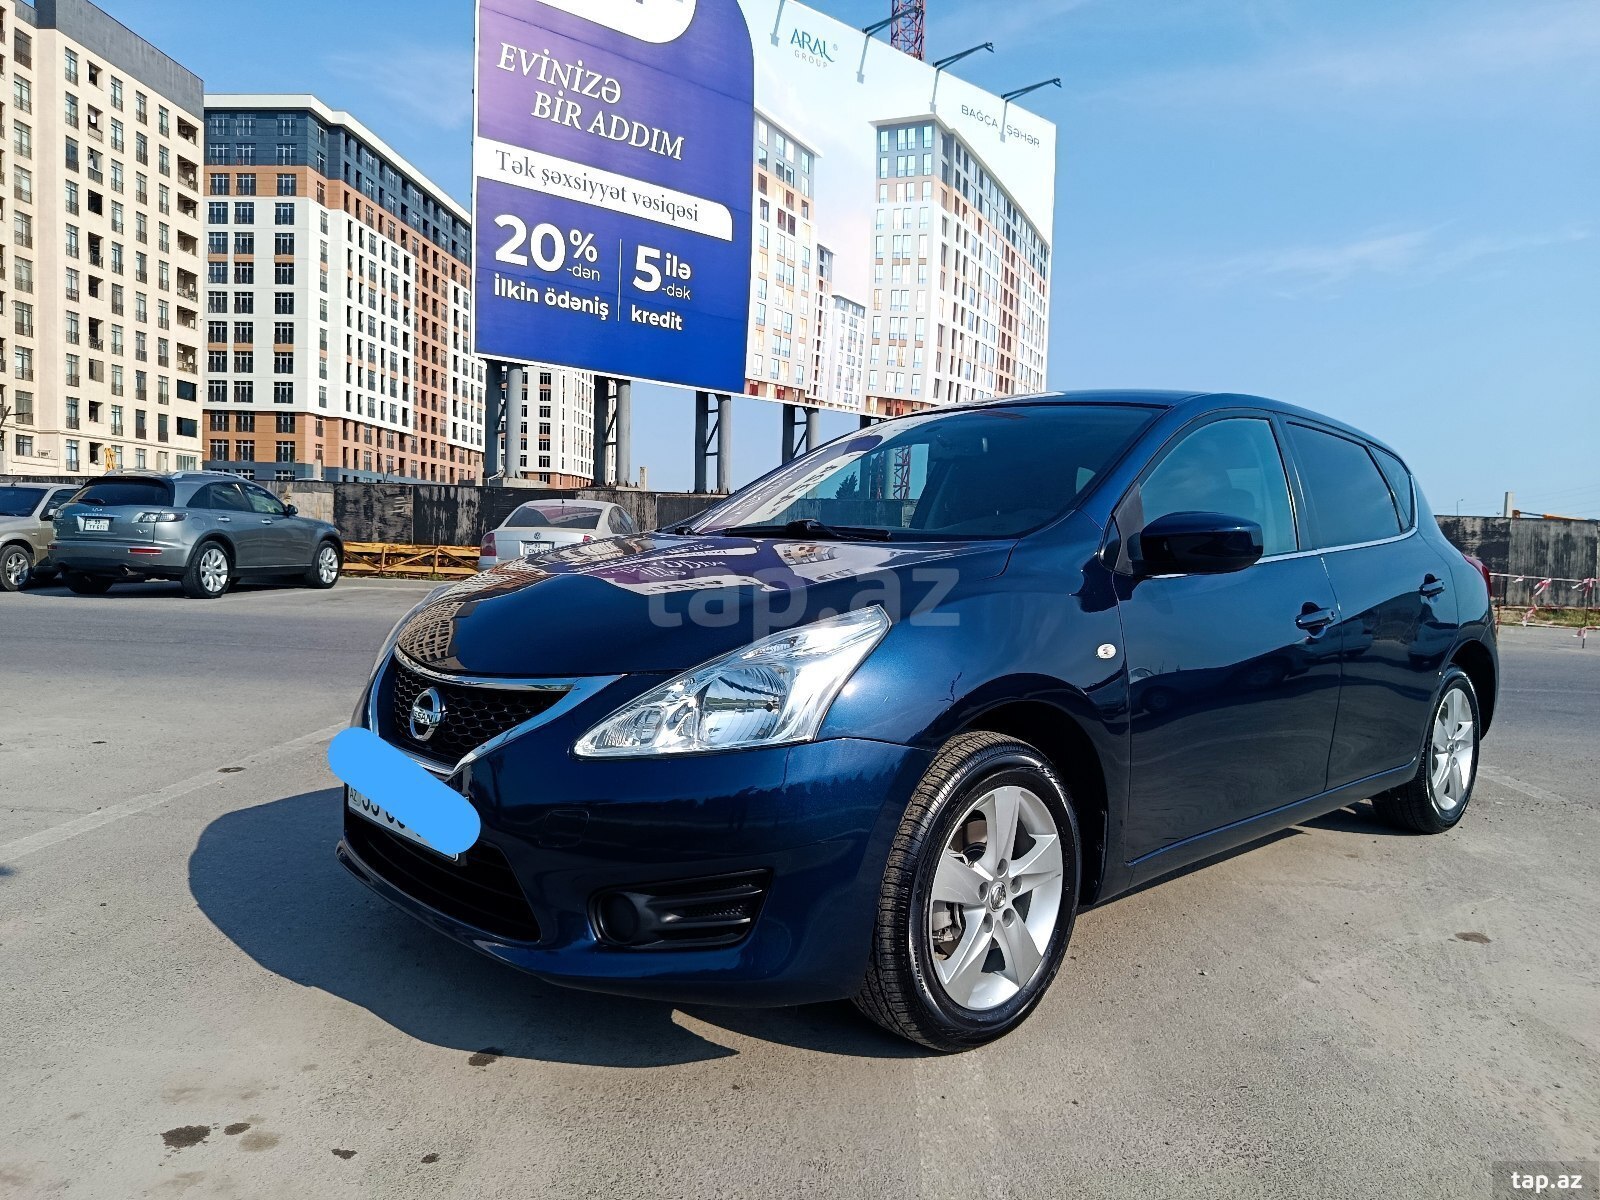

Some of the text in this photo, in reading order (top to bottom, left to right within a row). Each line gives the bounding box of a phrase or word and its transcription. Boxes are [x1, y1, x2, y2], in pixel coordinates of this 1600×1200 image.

[790, 28, 835, 63] ARAL
[794, 49, 828, 68] GROUP
[496, 42, 622, 104] EVİNİZƏ
[531, 90, 685, 161] BİR ADDIM
[495, 149, 699, 222] Tək şəxsiyyət vəsiqəsi
[632, 244, 692, 292] 5 ilə
[544, 286, 609, 321] ödəniş
[631, 304, 683, 331] kredit
